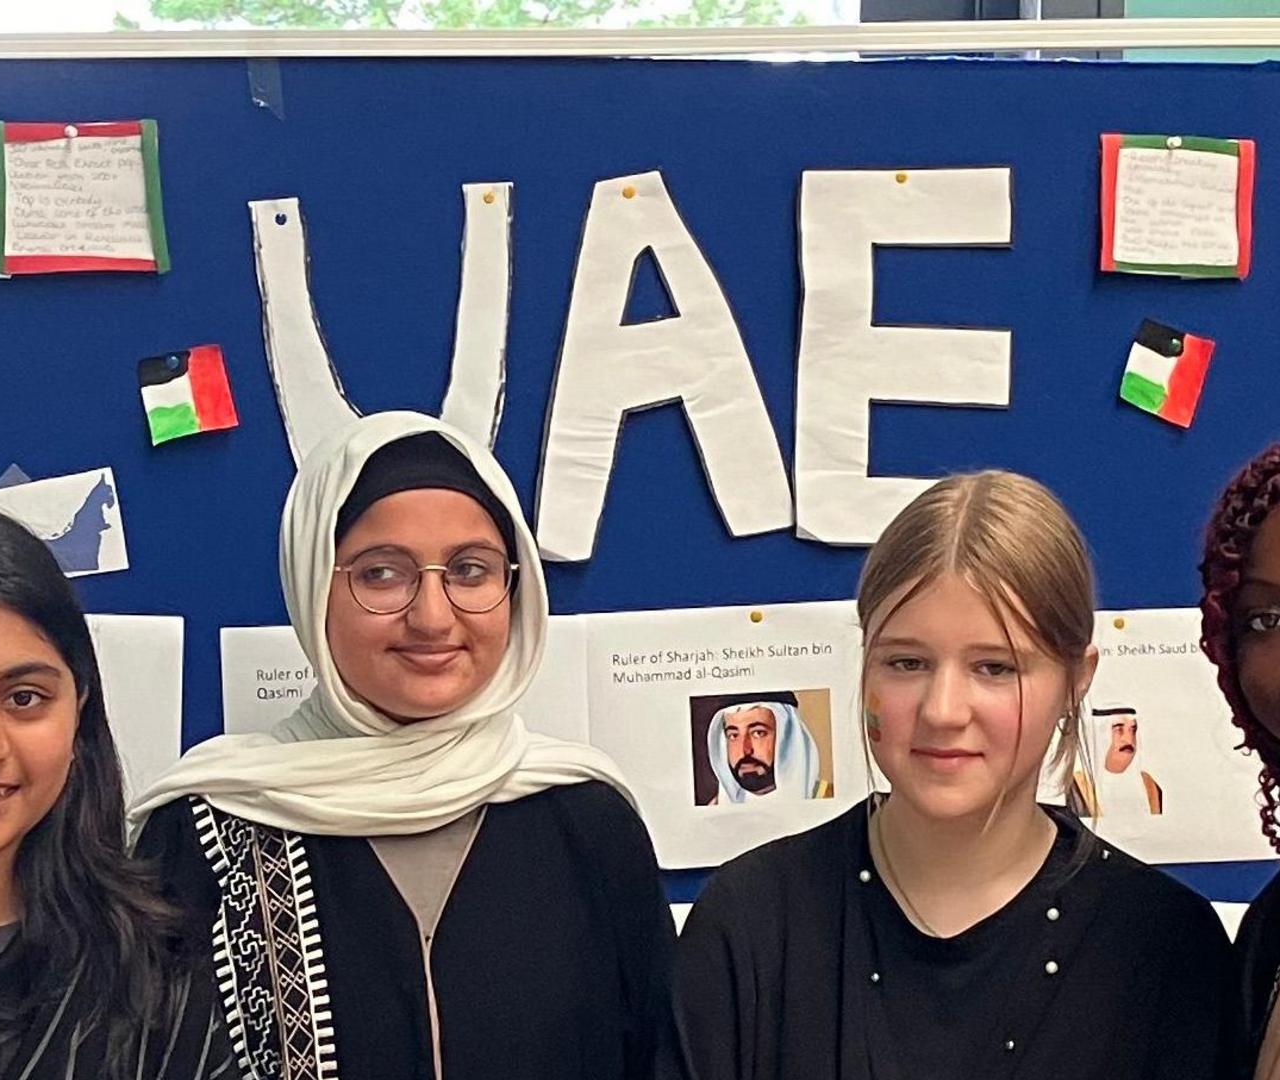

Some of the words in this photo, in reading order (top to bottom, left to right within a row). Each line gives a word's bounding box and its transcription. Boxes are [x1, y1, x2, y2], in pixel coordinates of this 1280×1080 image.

[248, 167, 1013, 562] UAE
[612, 654, 645, 666] Ruler
[650, 653, 662, 664] of
[722, 646, 764, 660] Sheikh
[768, 646, 808, 658] Sultan
[812, 643, 832, 655] bin
[1118, 644, 1156, 656] Sheikh
[1159, 643, 1187, 654] Saud
[256, 668, 291, 681] Ruler
[295, 666, 309, 680] of
[613, 670, 692, 684] Muhammad
[696, 666, 756, 680] al-Qasimi
[256, 687, 302, 700] Qasimi
